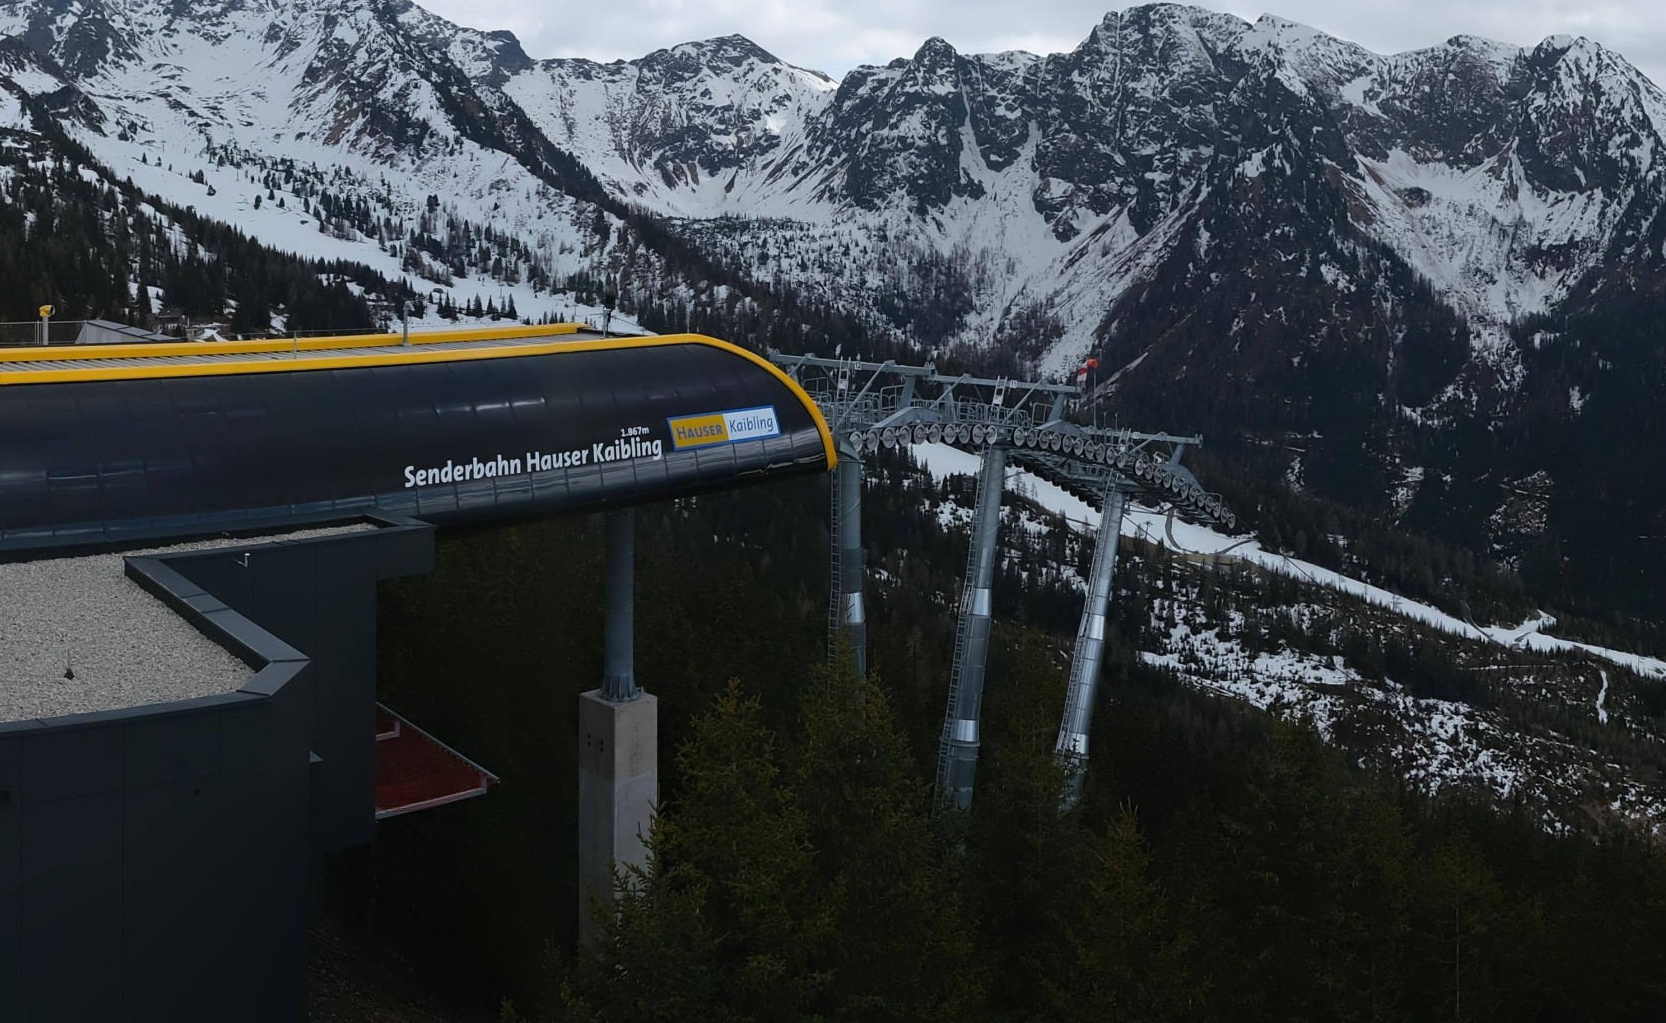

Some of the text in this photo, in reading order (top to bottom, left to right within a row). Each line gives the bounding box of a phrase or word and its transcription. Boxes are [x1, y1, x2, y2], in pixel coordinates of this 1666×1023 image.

[620, 426, 650, 438] 1.867m
[676, 415, 774, 440] HAUSER Kaibling
[404, 436, 662, 488] Senderbahn Hauser Kaibling
